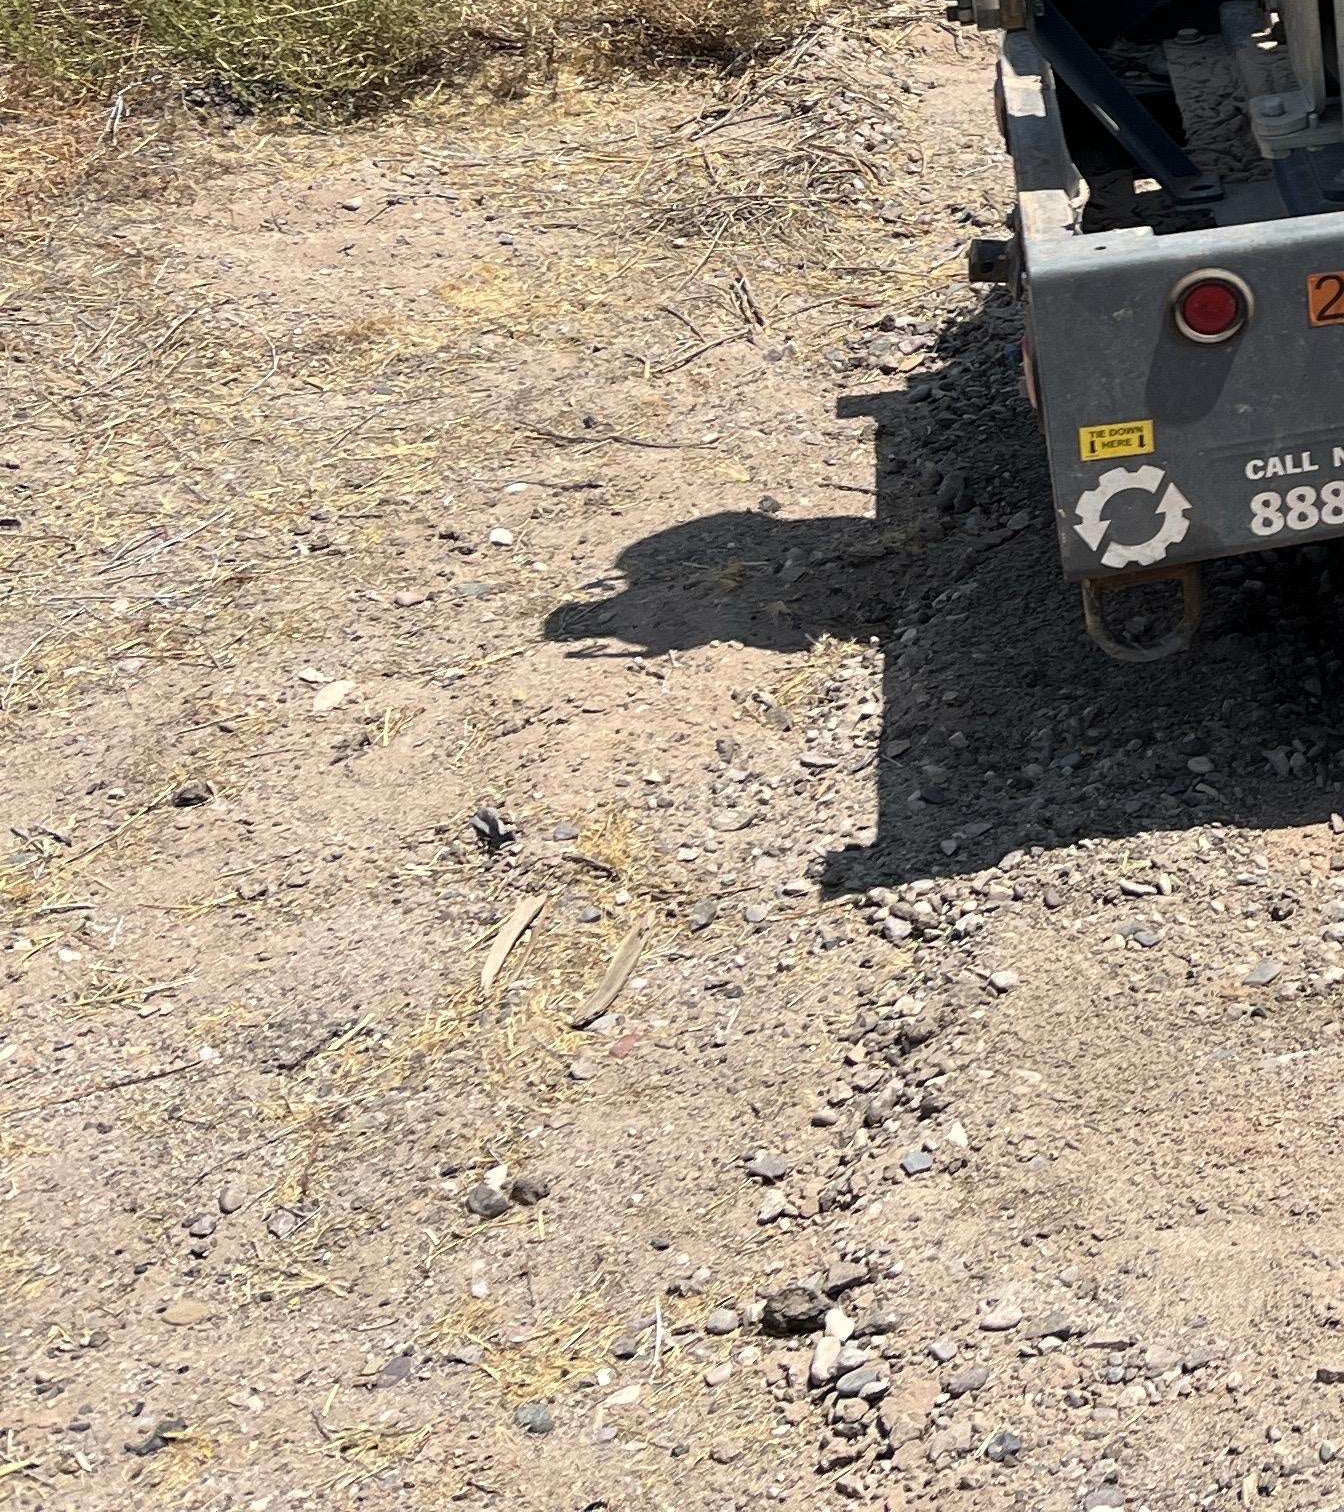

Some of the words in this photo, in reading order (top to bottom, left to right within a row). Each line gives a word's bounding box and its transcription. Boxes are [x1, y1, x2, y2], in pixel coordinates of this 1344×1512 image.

[1108, 426, 1144, 437] DOWN
[1101, 438, 1133, 449] HERE
[1244, 451, 1320, 481] CALL
